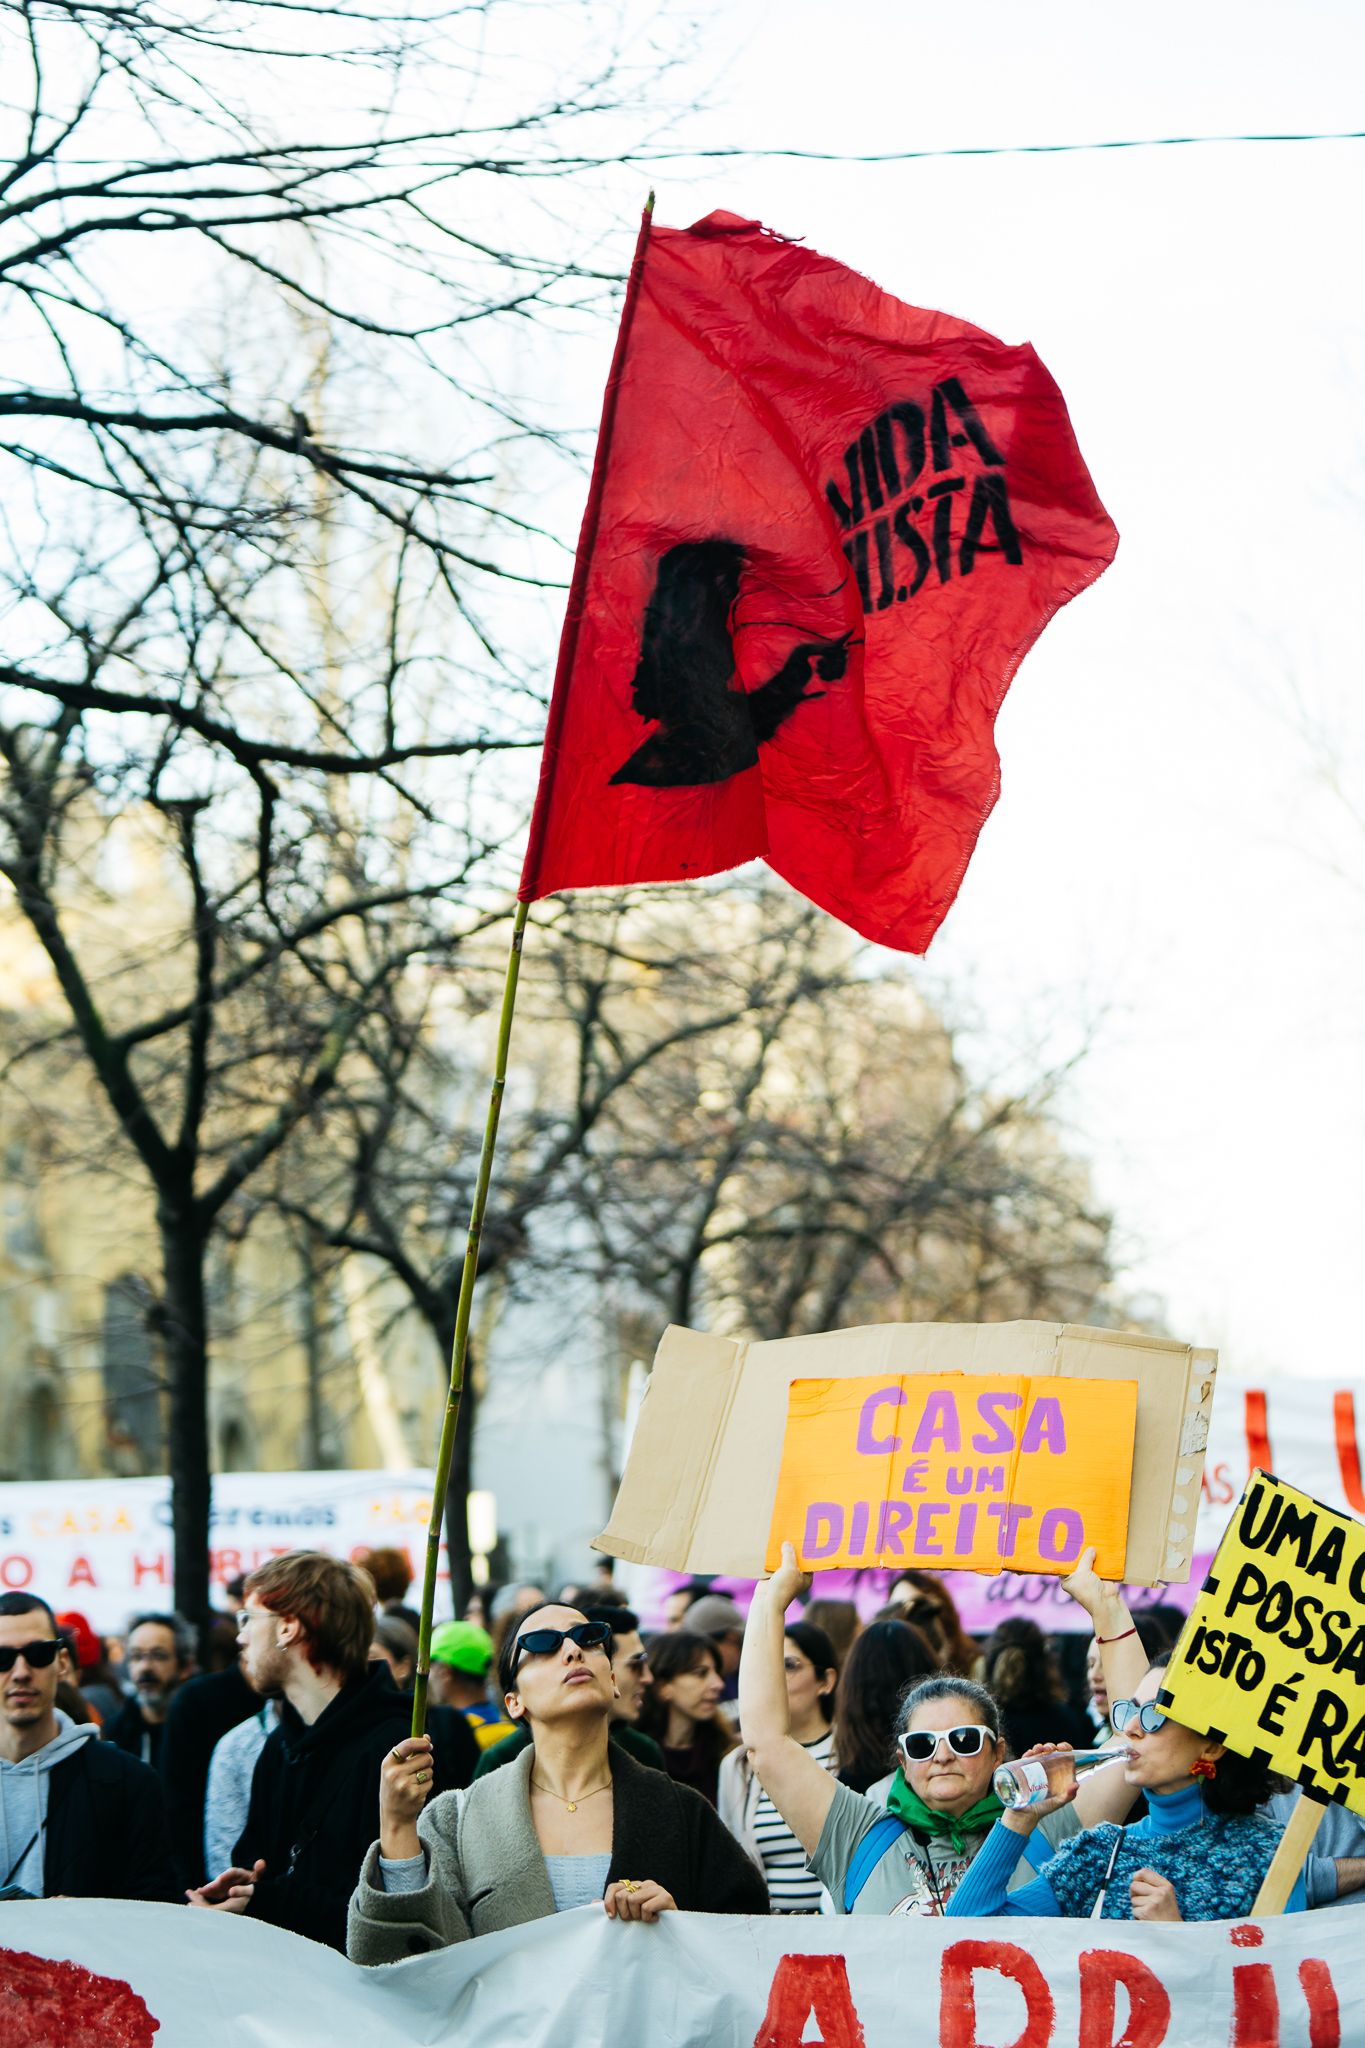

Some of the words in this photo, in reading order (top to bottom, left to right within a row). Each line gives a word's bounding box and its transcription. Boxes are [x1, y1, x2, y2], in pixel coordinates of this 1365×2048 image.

[824, 376, 1006, 532] VIDA
[842, 475, 1023, 615] USTA
[856, 1386, 1066, 1455] CASA
[902, 1459, 930, 1493] É
[945, 1466, 1005, 1495] UM
[802, 1500, 1084, 1562] DIREITO
[1239, 1483, 1347, 1585] UMA
[1257, 1671, 1305, 1737] É
[1297, 1689, 1365, 1779] RA
